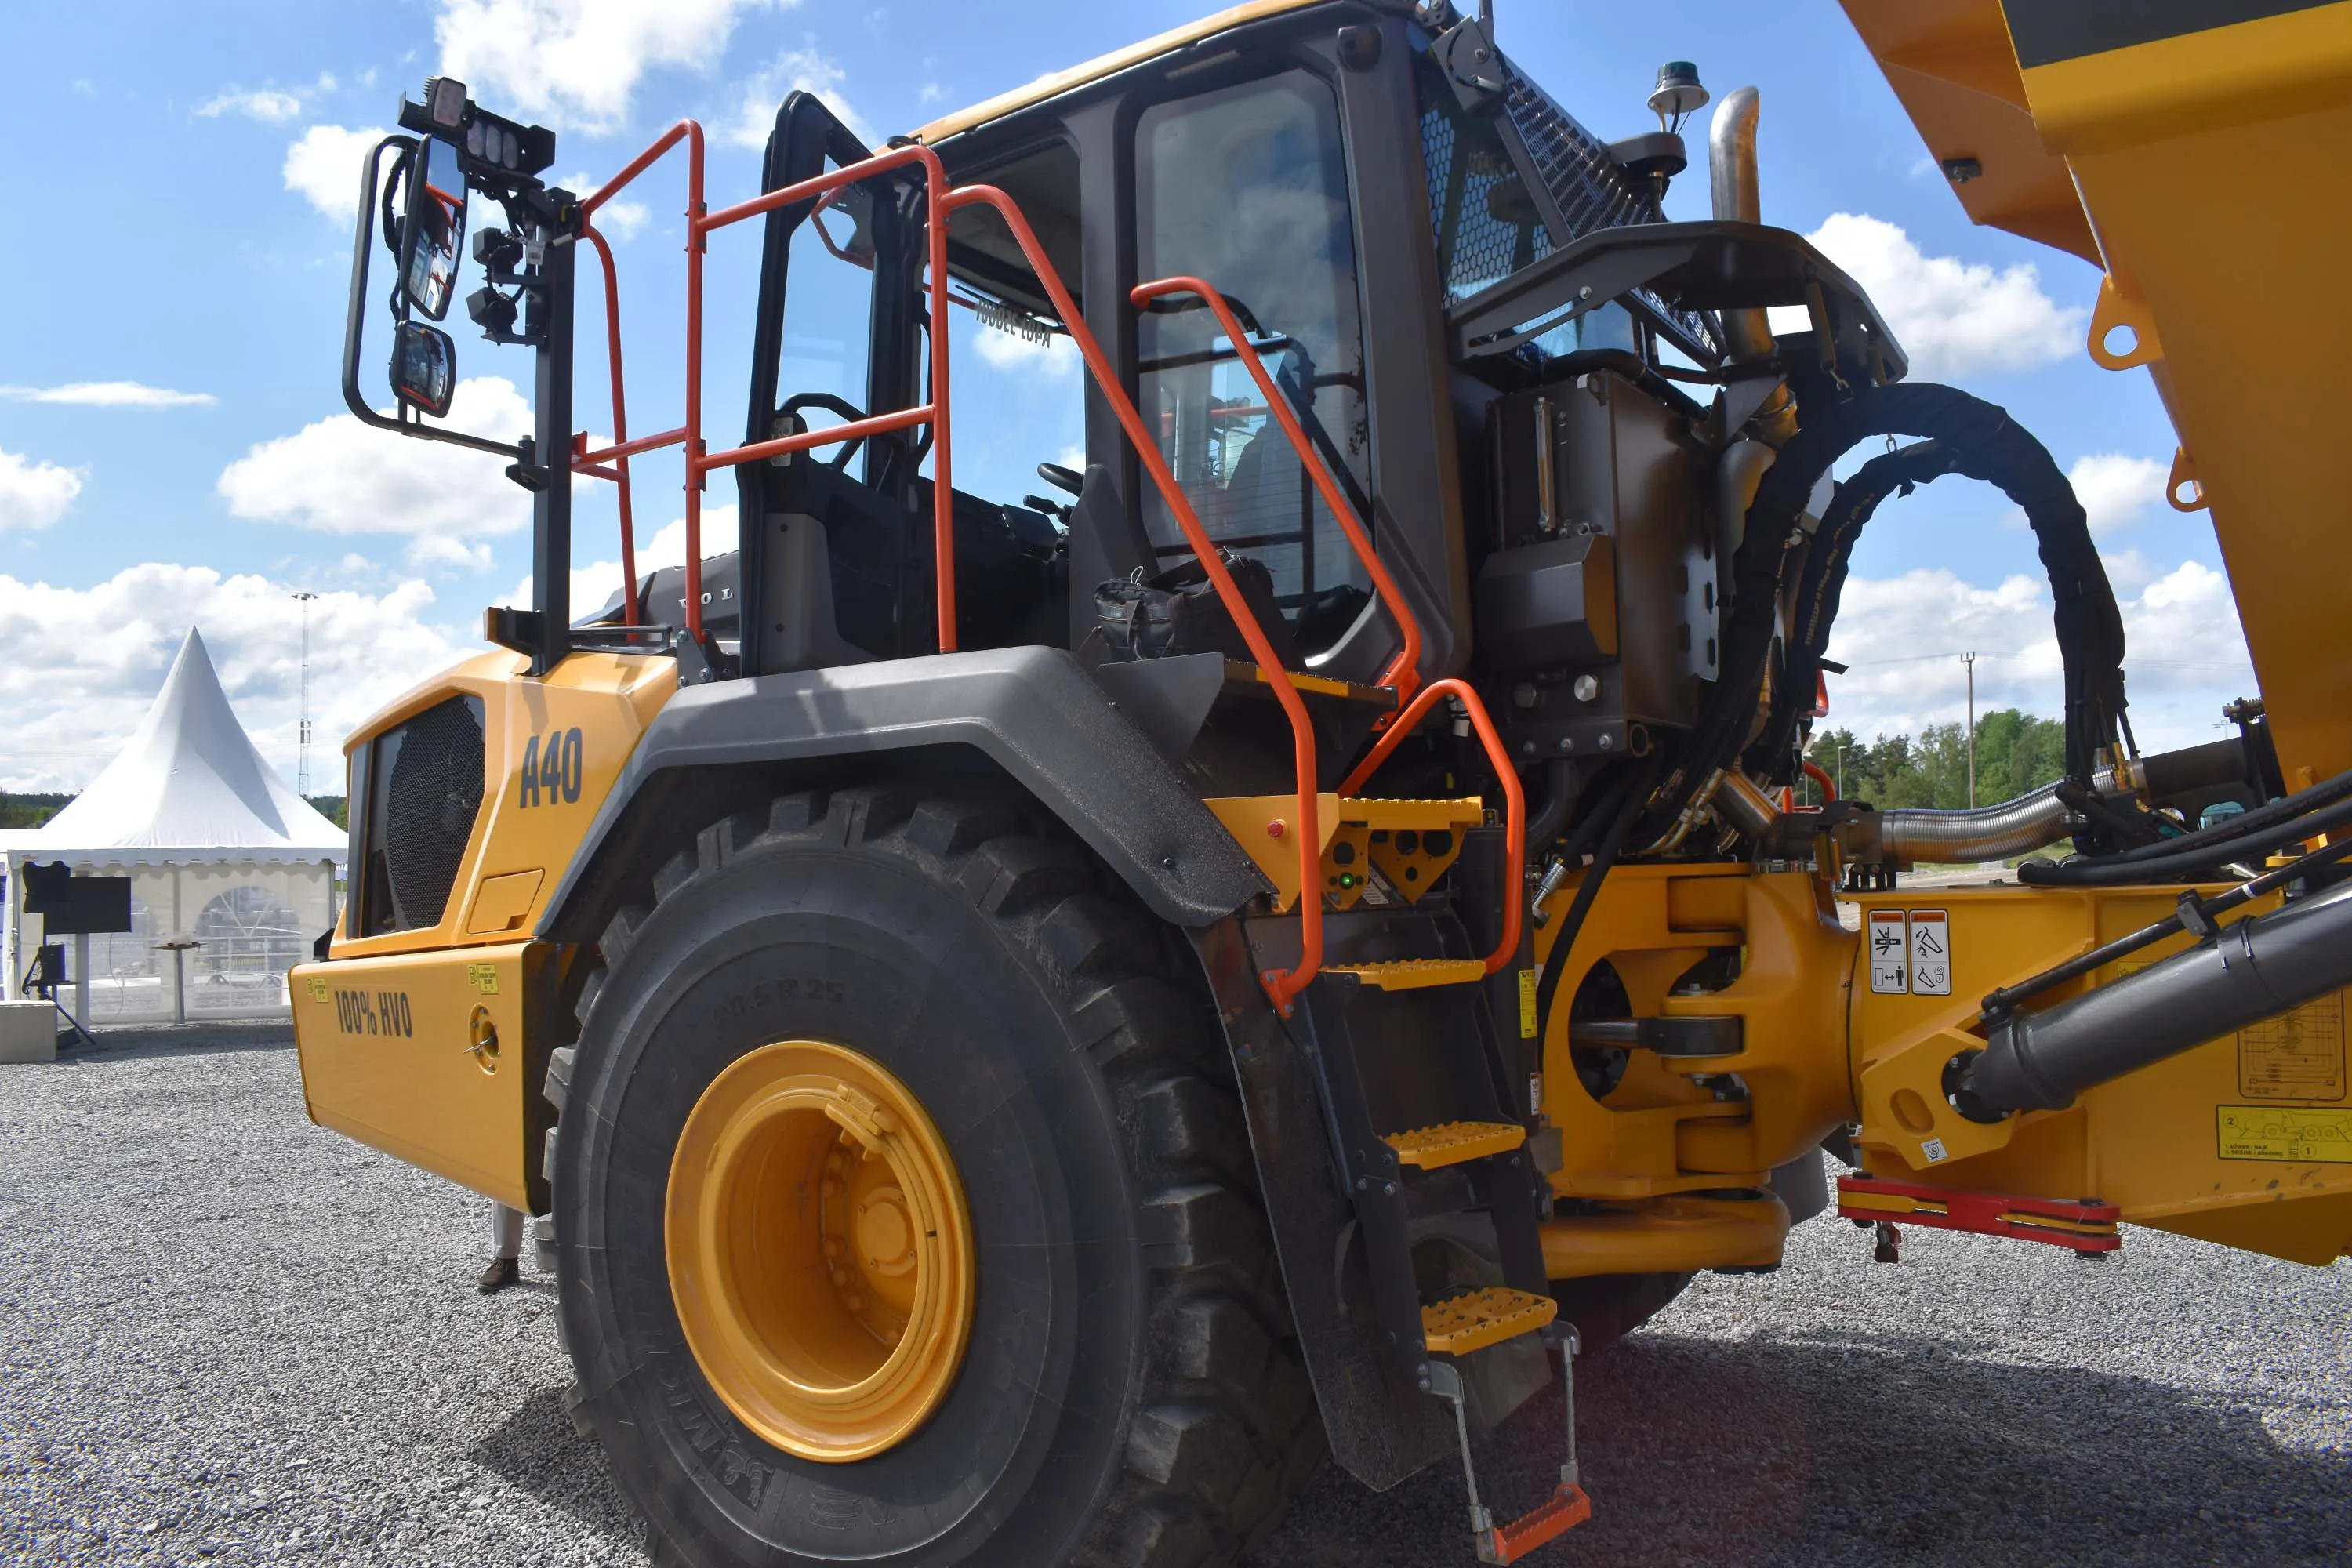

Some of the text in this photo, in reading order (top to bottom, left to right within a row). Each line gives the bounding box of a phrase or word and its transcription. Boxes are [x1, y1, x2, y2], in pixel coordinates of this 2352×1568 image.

[519, 726, 583, 809] A40
[335, 990, 412, 1038] 100% HVO
